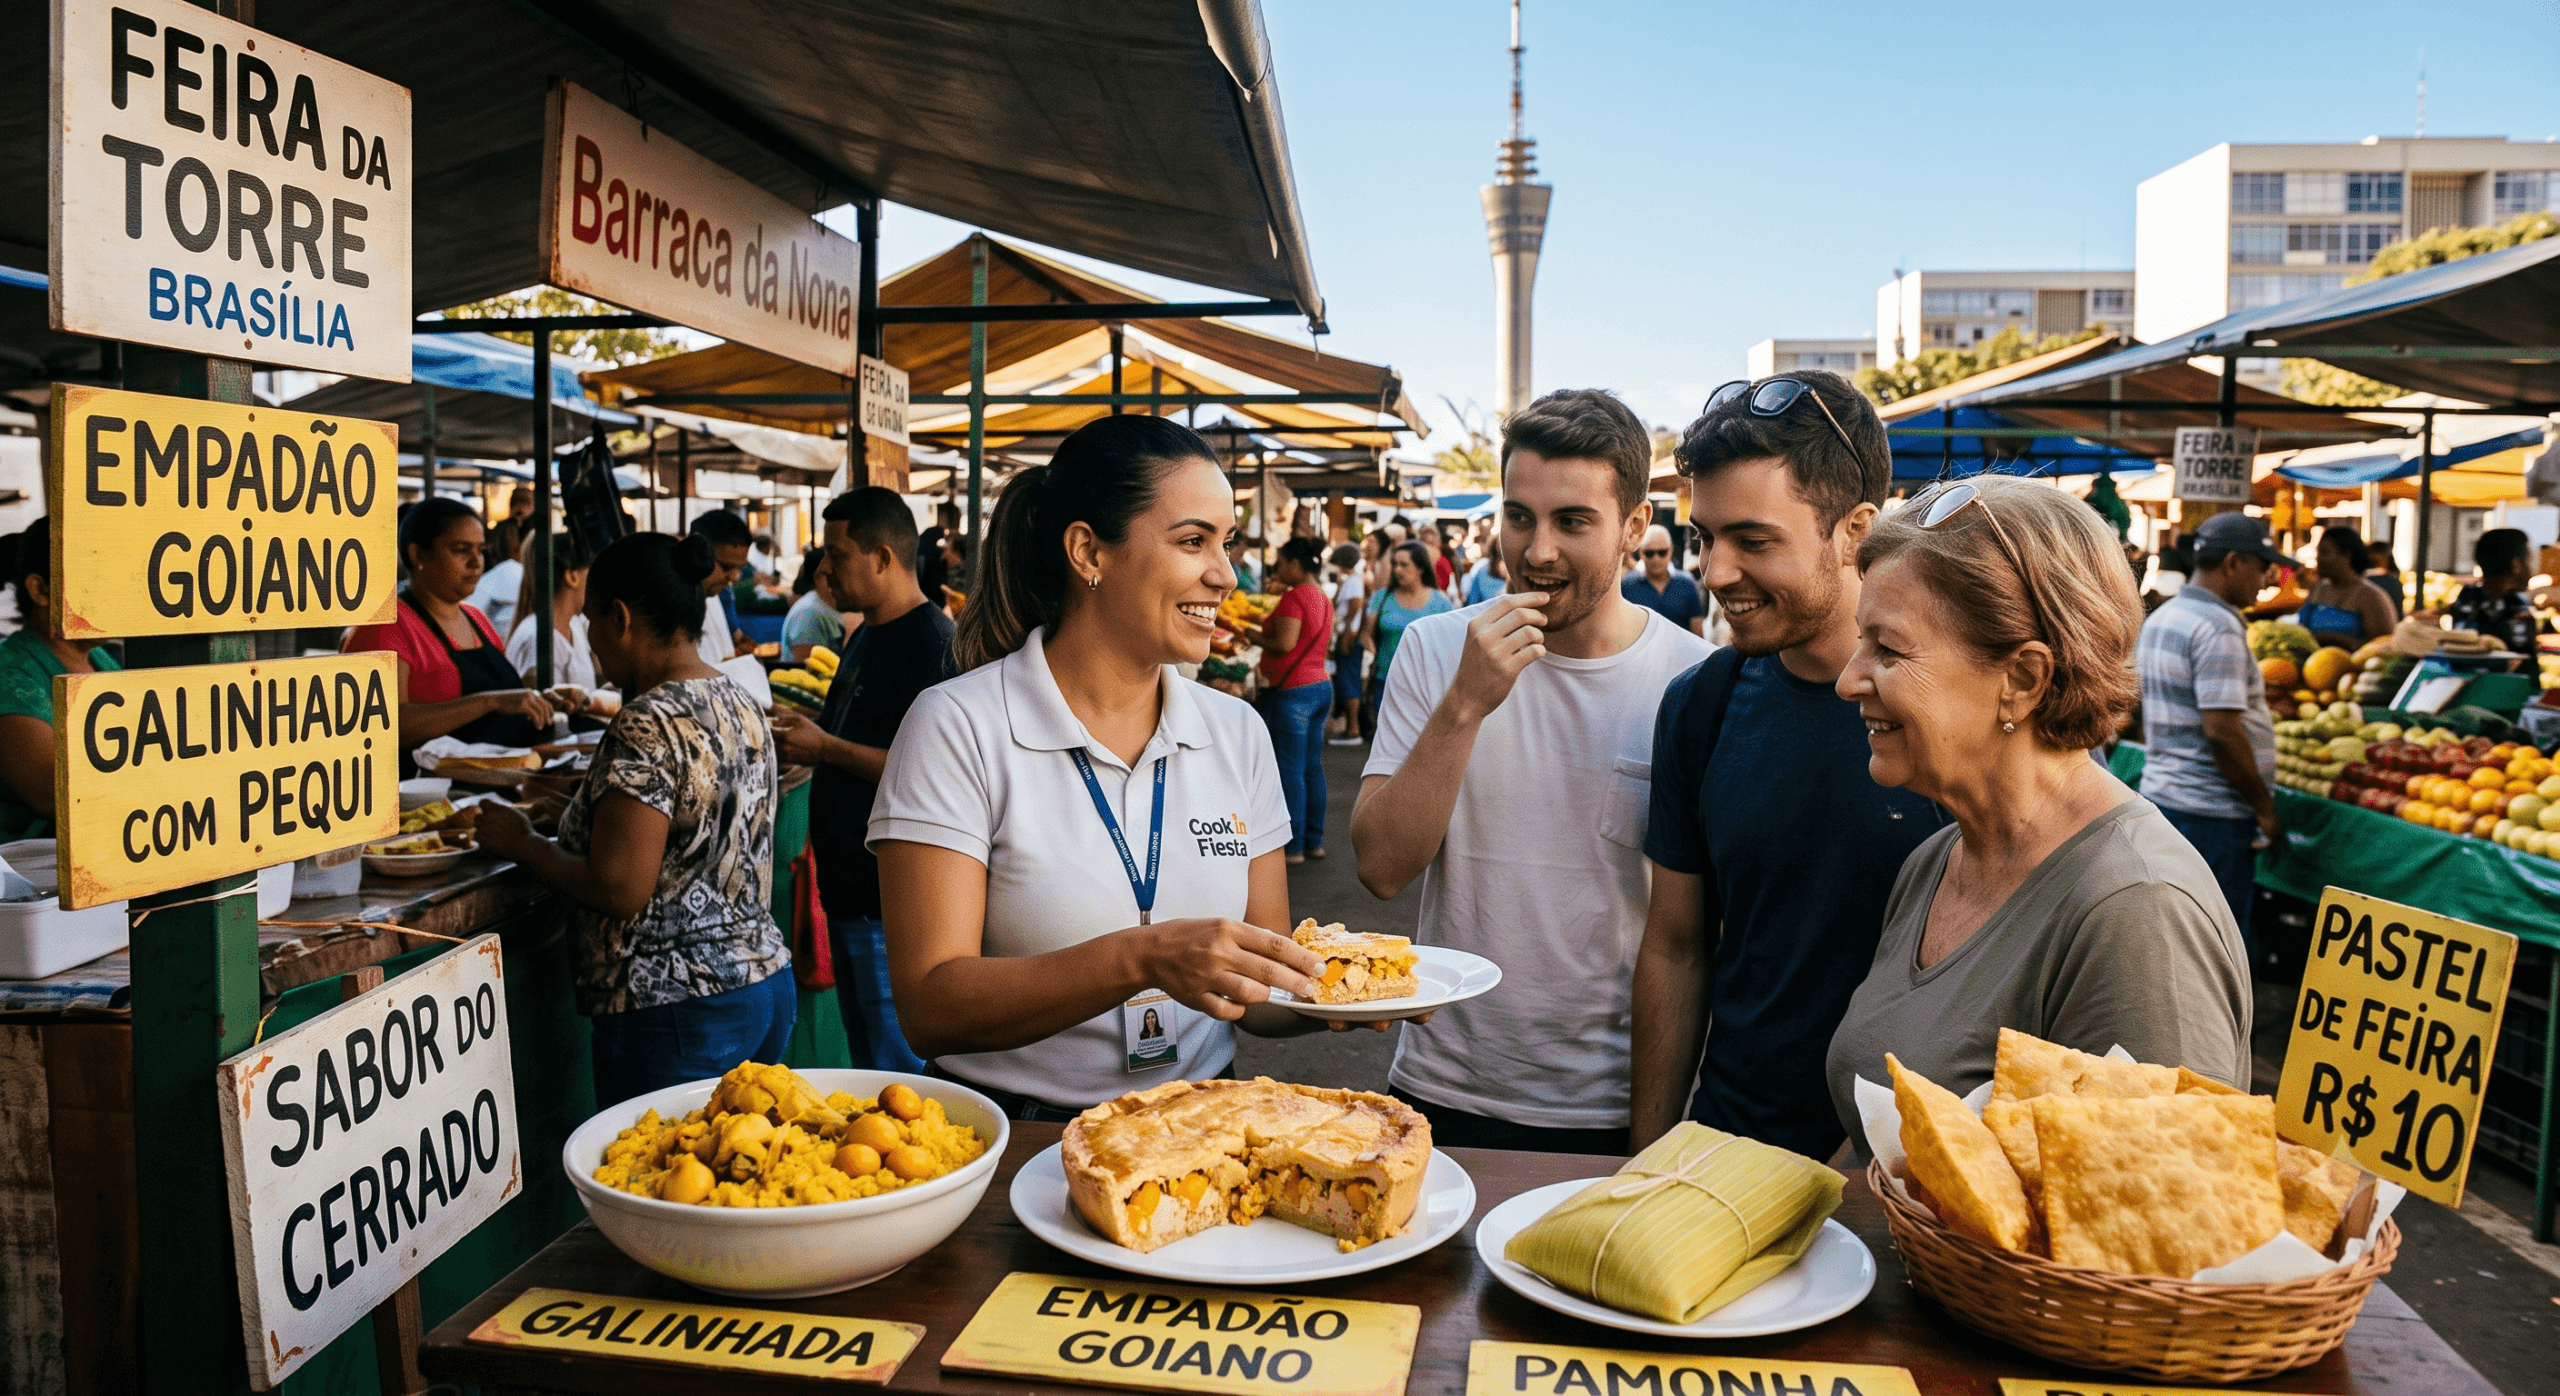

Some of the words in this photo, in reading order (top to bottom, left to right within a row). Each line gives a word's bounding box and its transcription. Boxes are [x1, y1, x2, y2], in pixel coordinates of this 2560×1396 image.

[111, 6, 327, 172] FEIRA
[342, 126, 392, 191] DA
[102, 135, 370, 289] TORRE
[572, 134, 733, 298] Barraca
[744, 222, 779, 316] da
[788, 240, 851, 341] Nona
[149, 267, 355, 352] BRASÍLIA
[863, 363, 892, 399] FEIRA
[85, 414, 376, 518] EMPADÃO
[2181, 432, 2236, 455] FEIRA
[2184, 457, 2244, 480] TORRE
[83, 669, 391, 773] GALINHADA
[123, 796, 217, 863] COM
[1196, 837, 1248, 857] Fiesta
[2316, 903, 2493, 1013] PASTEL
[2299, 987, 2347, 1042] DE
[266, 994, 445, 1168] SABOR
[453, 982, 497, 1056] DO
[2302, 1061, 2378, 1148] R$
[2380, 1089, 2466, 1183] 10
[281, 1088, 500, 1312] CERRADO
[521, 1300, 876, 1367] GALINHADA
[1036, 1286, 1350, 1342] EMPADÃO
[1057, 1330, 1314, 1384] GOIANO
